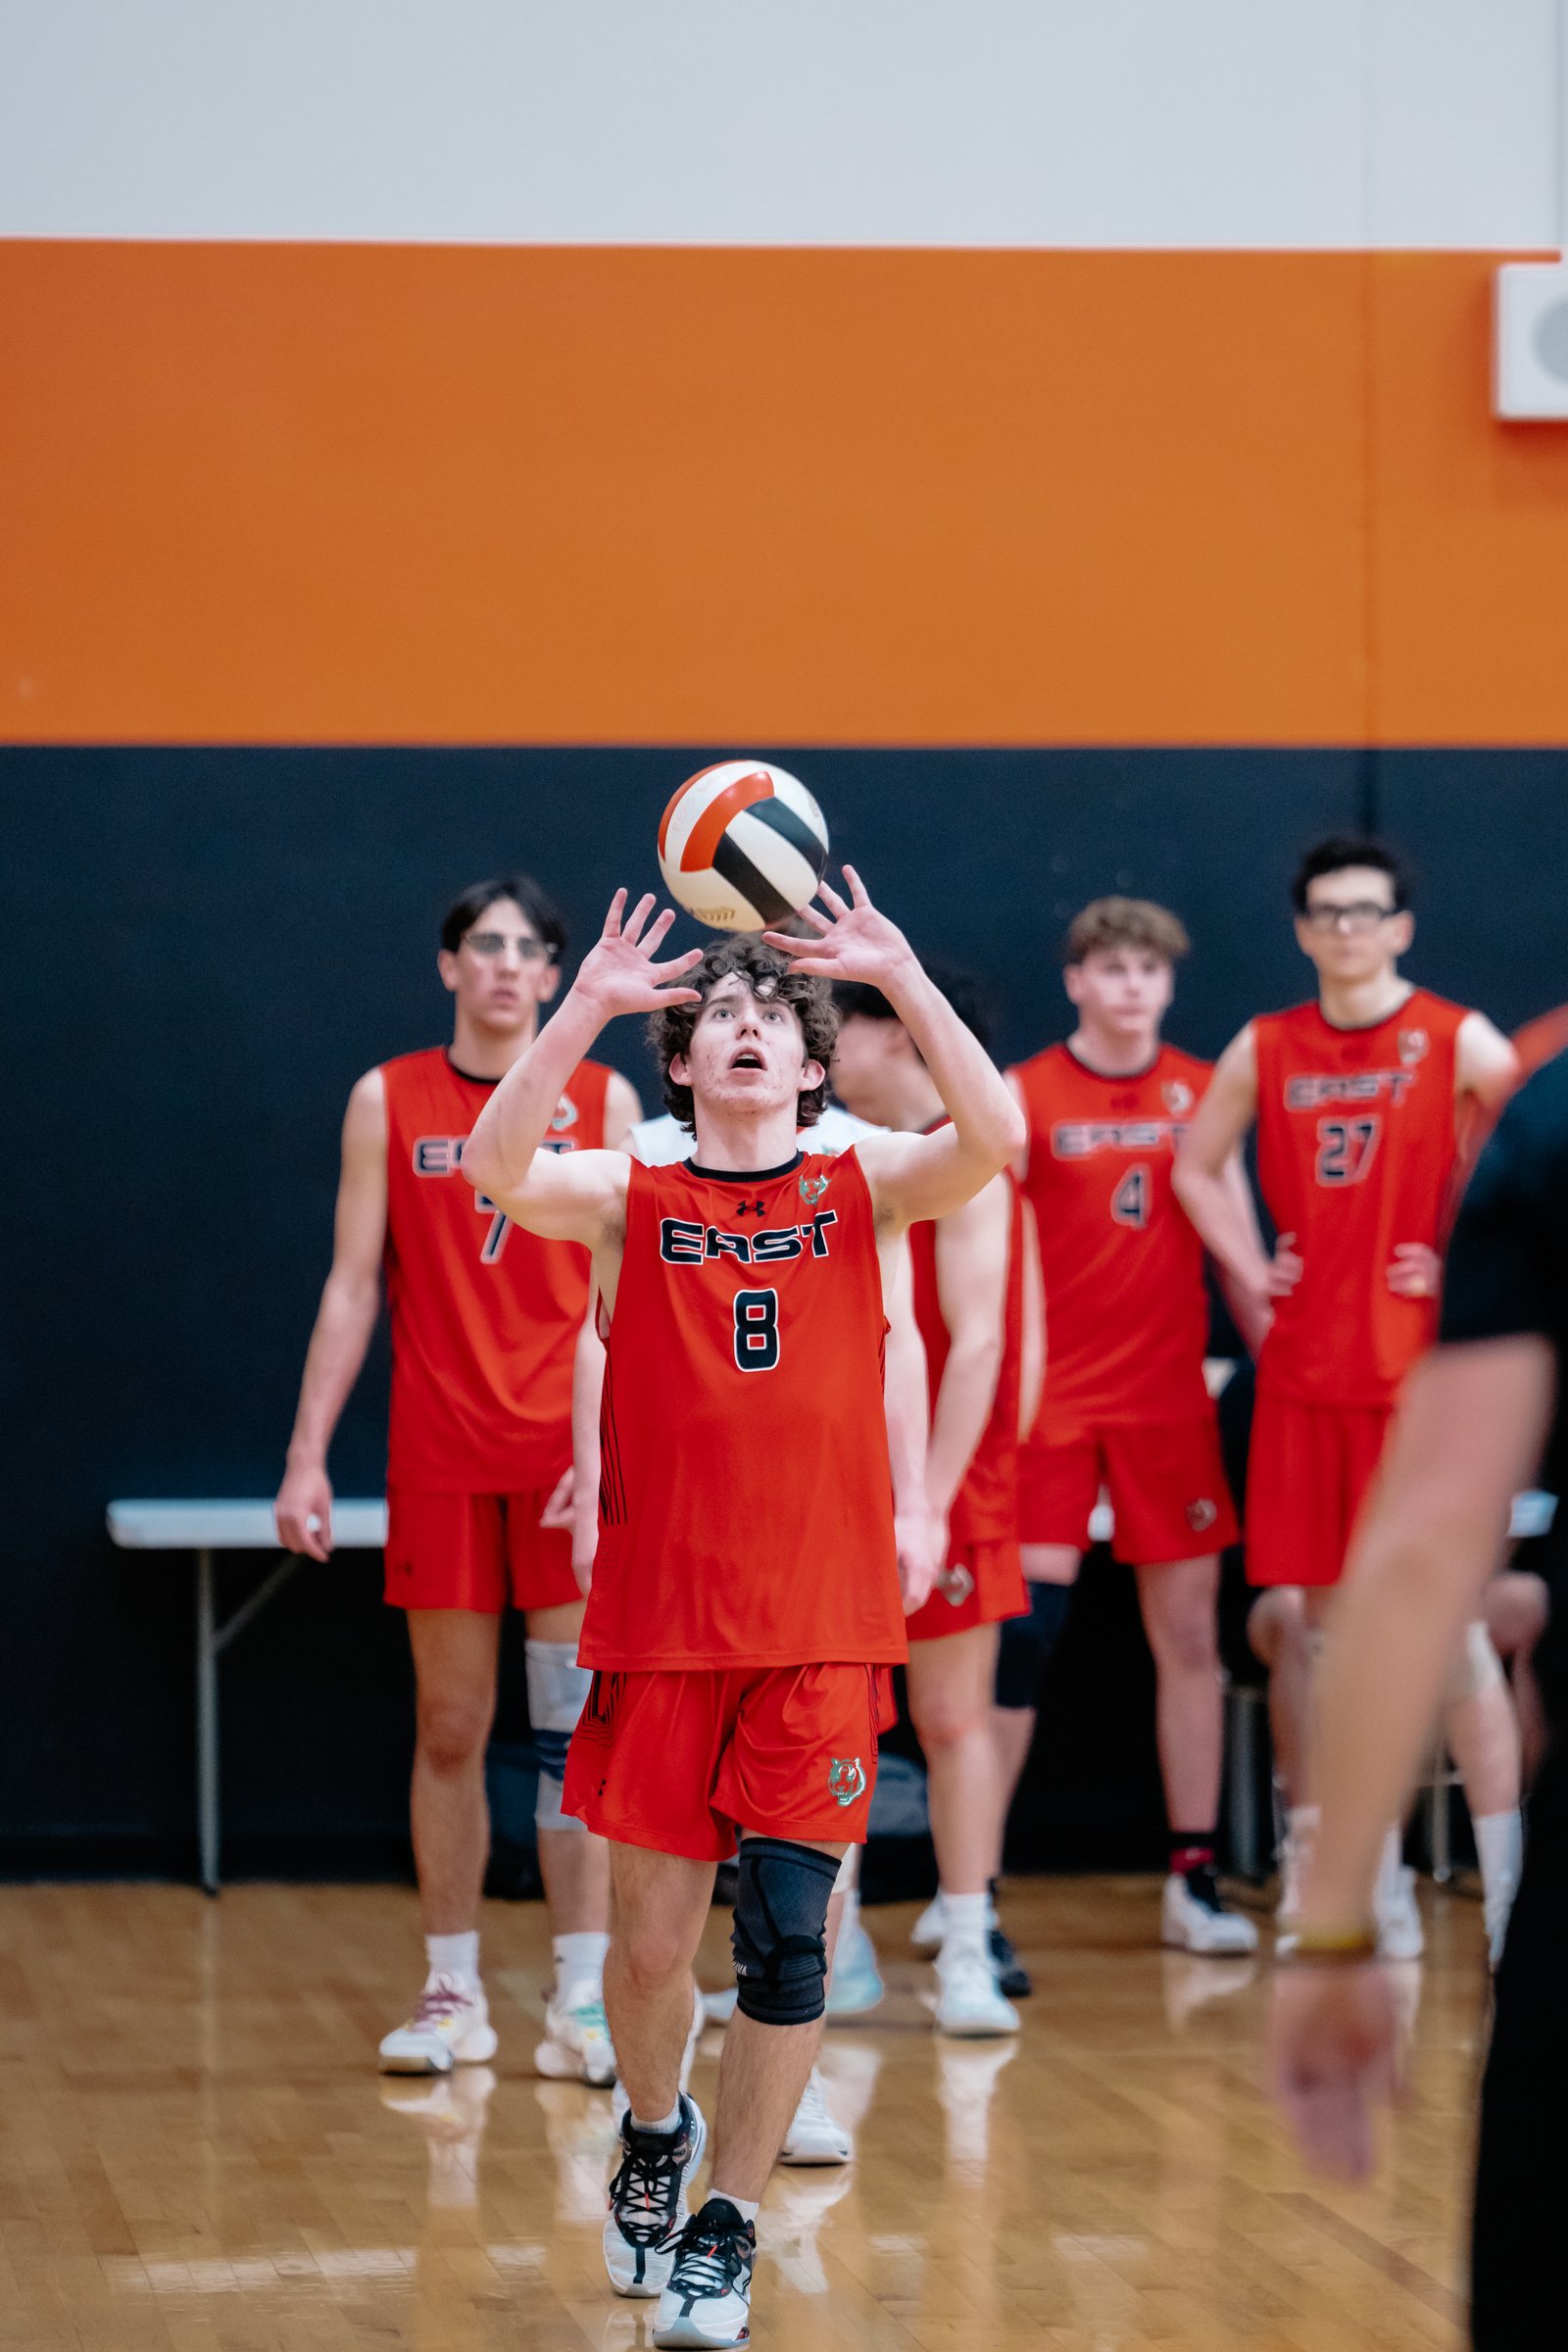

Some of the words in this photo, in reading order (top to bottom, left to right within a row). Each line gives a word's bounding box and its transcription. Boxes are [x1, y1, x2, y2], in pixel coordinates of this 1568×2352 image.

[1285, 1070, 1415, 1111] EAST
[1316, 1115, 1380, 1186] 27
[1111, 1164, 1152, 1228] 4
[660, 1209, 838, 1264] EAST
[733, 1288, 780, 1372] 8
